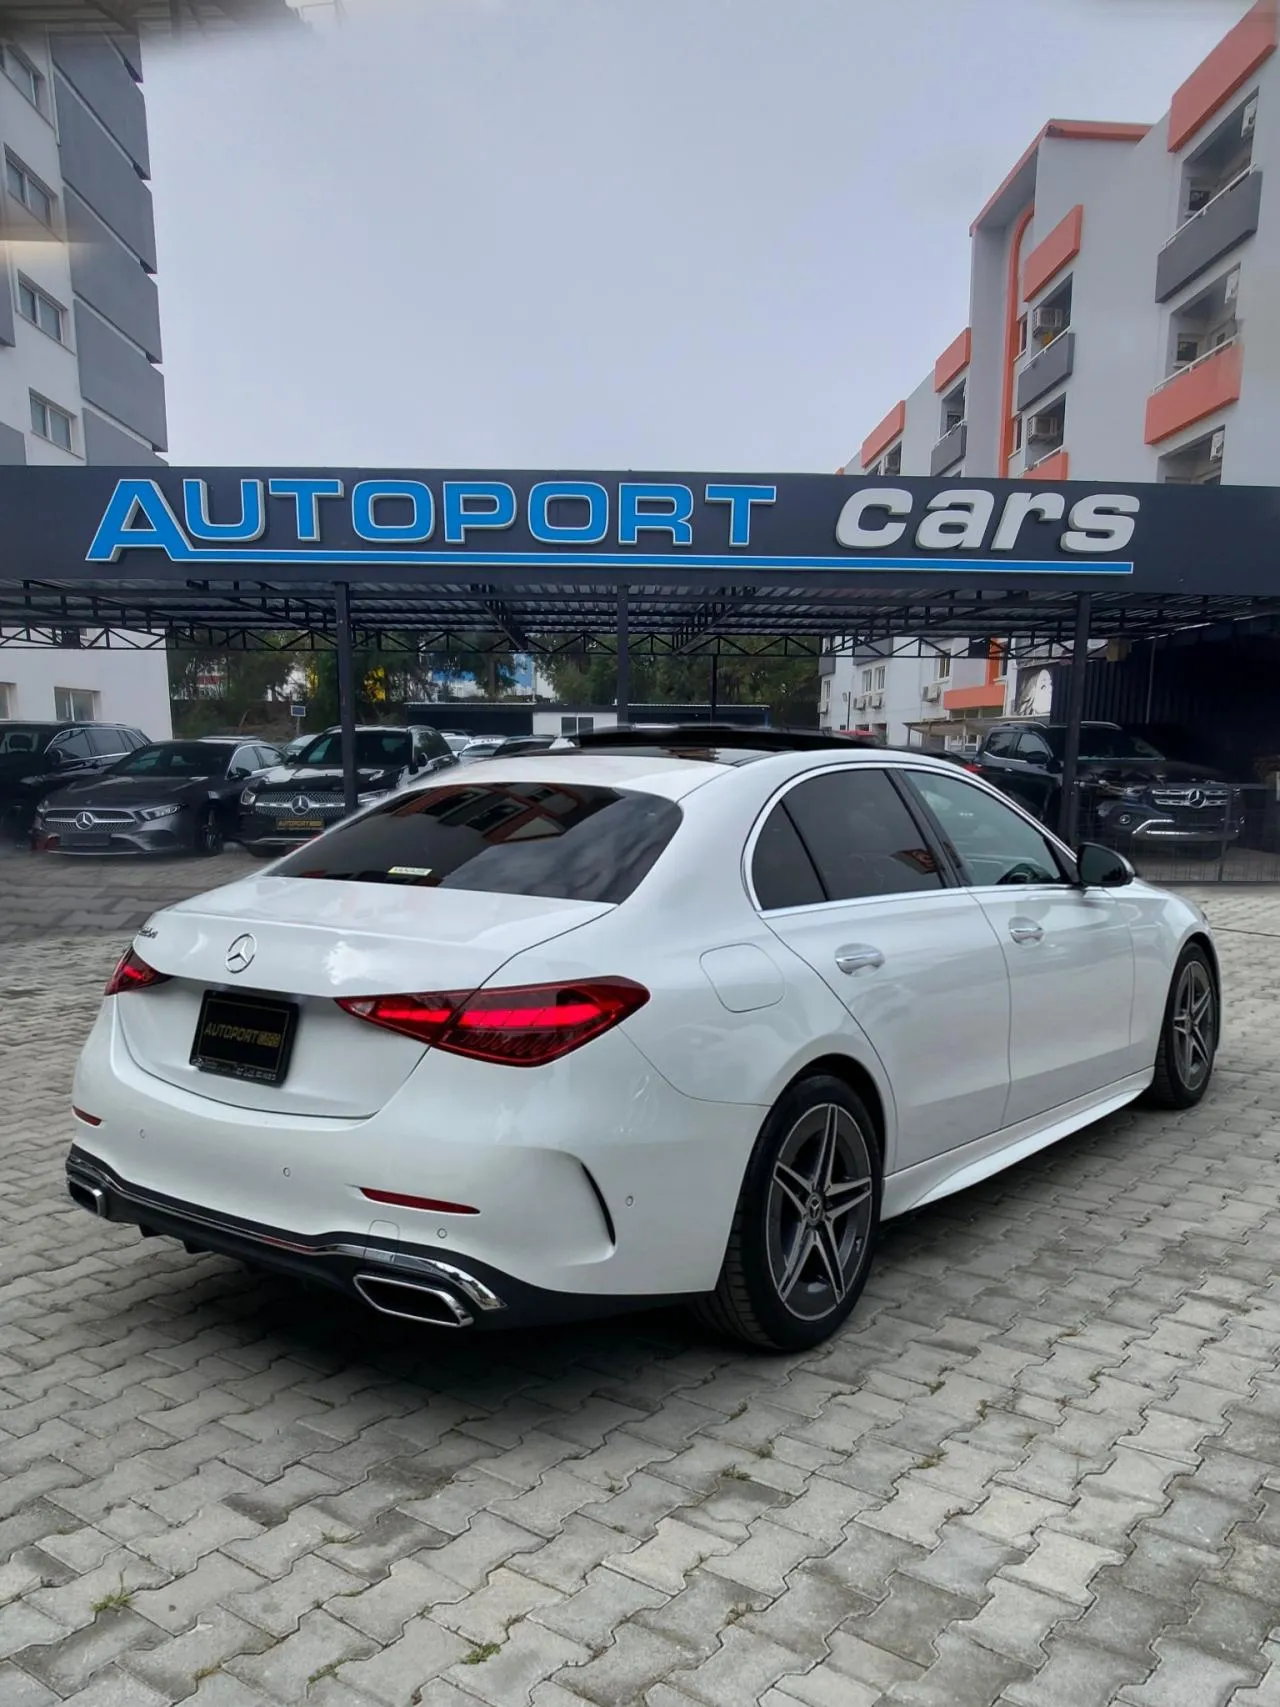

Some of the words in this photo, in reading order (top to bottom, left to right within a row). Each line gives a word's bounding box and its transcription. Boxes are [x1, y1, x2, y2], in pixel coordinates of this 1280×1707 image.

[85, 478, 779, 562] AUTOPORT
[836, 487, 1140, 553] cars
[204, 1022, 259, 1044] AUTOPORT
